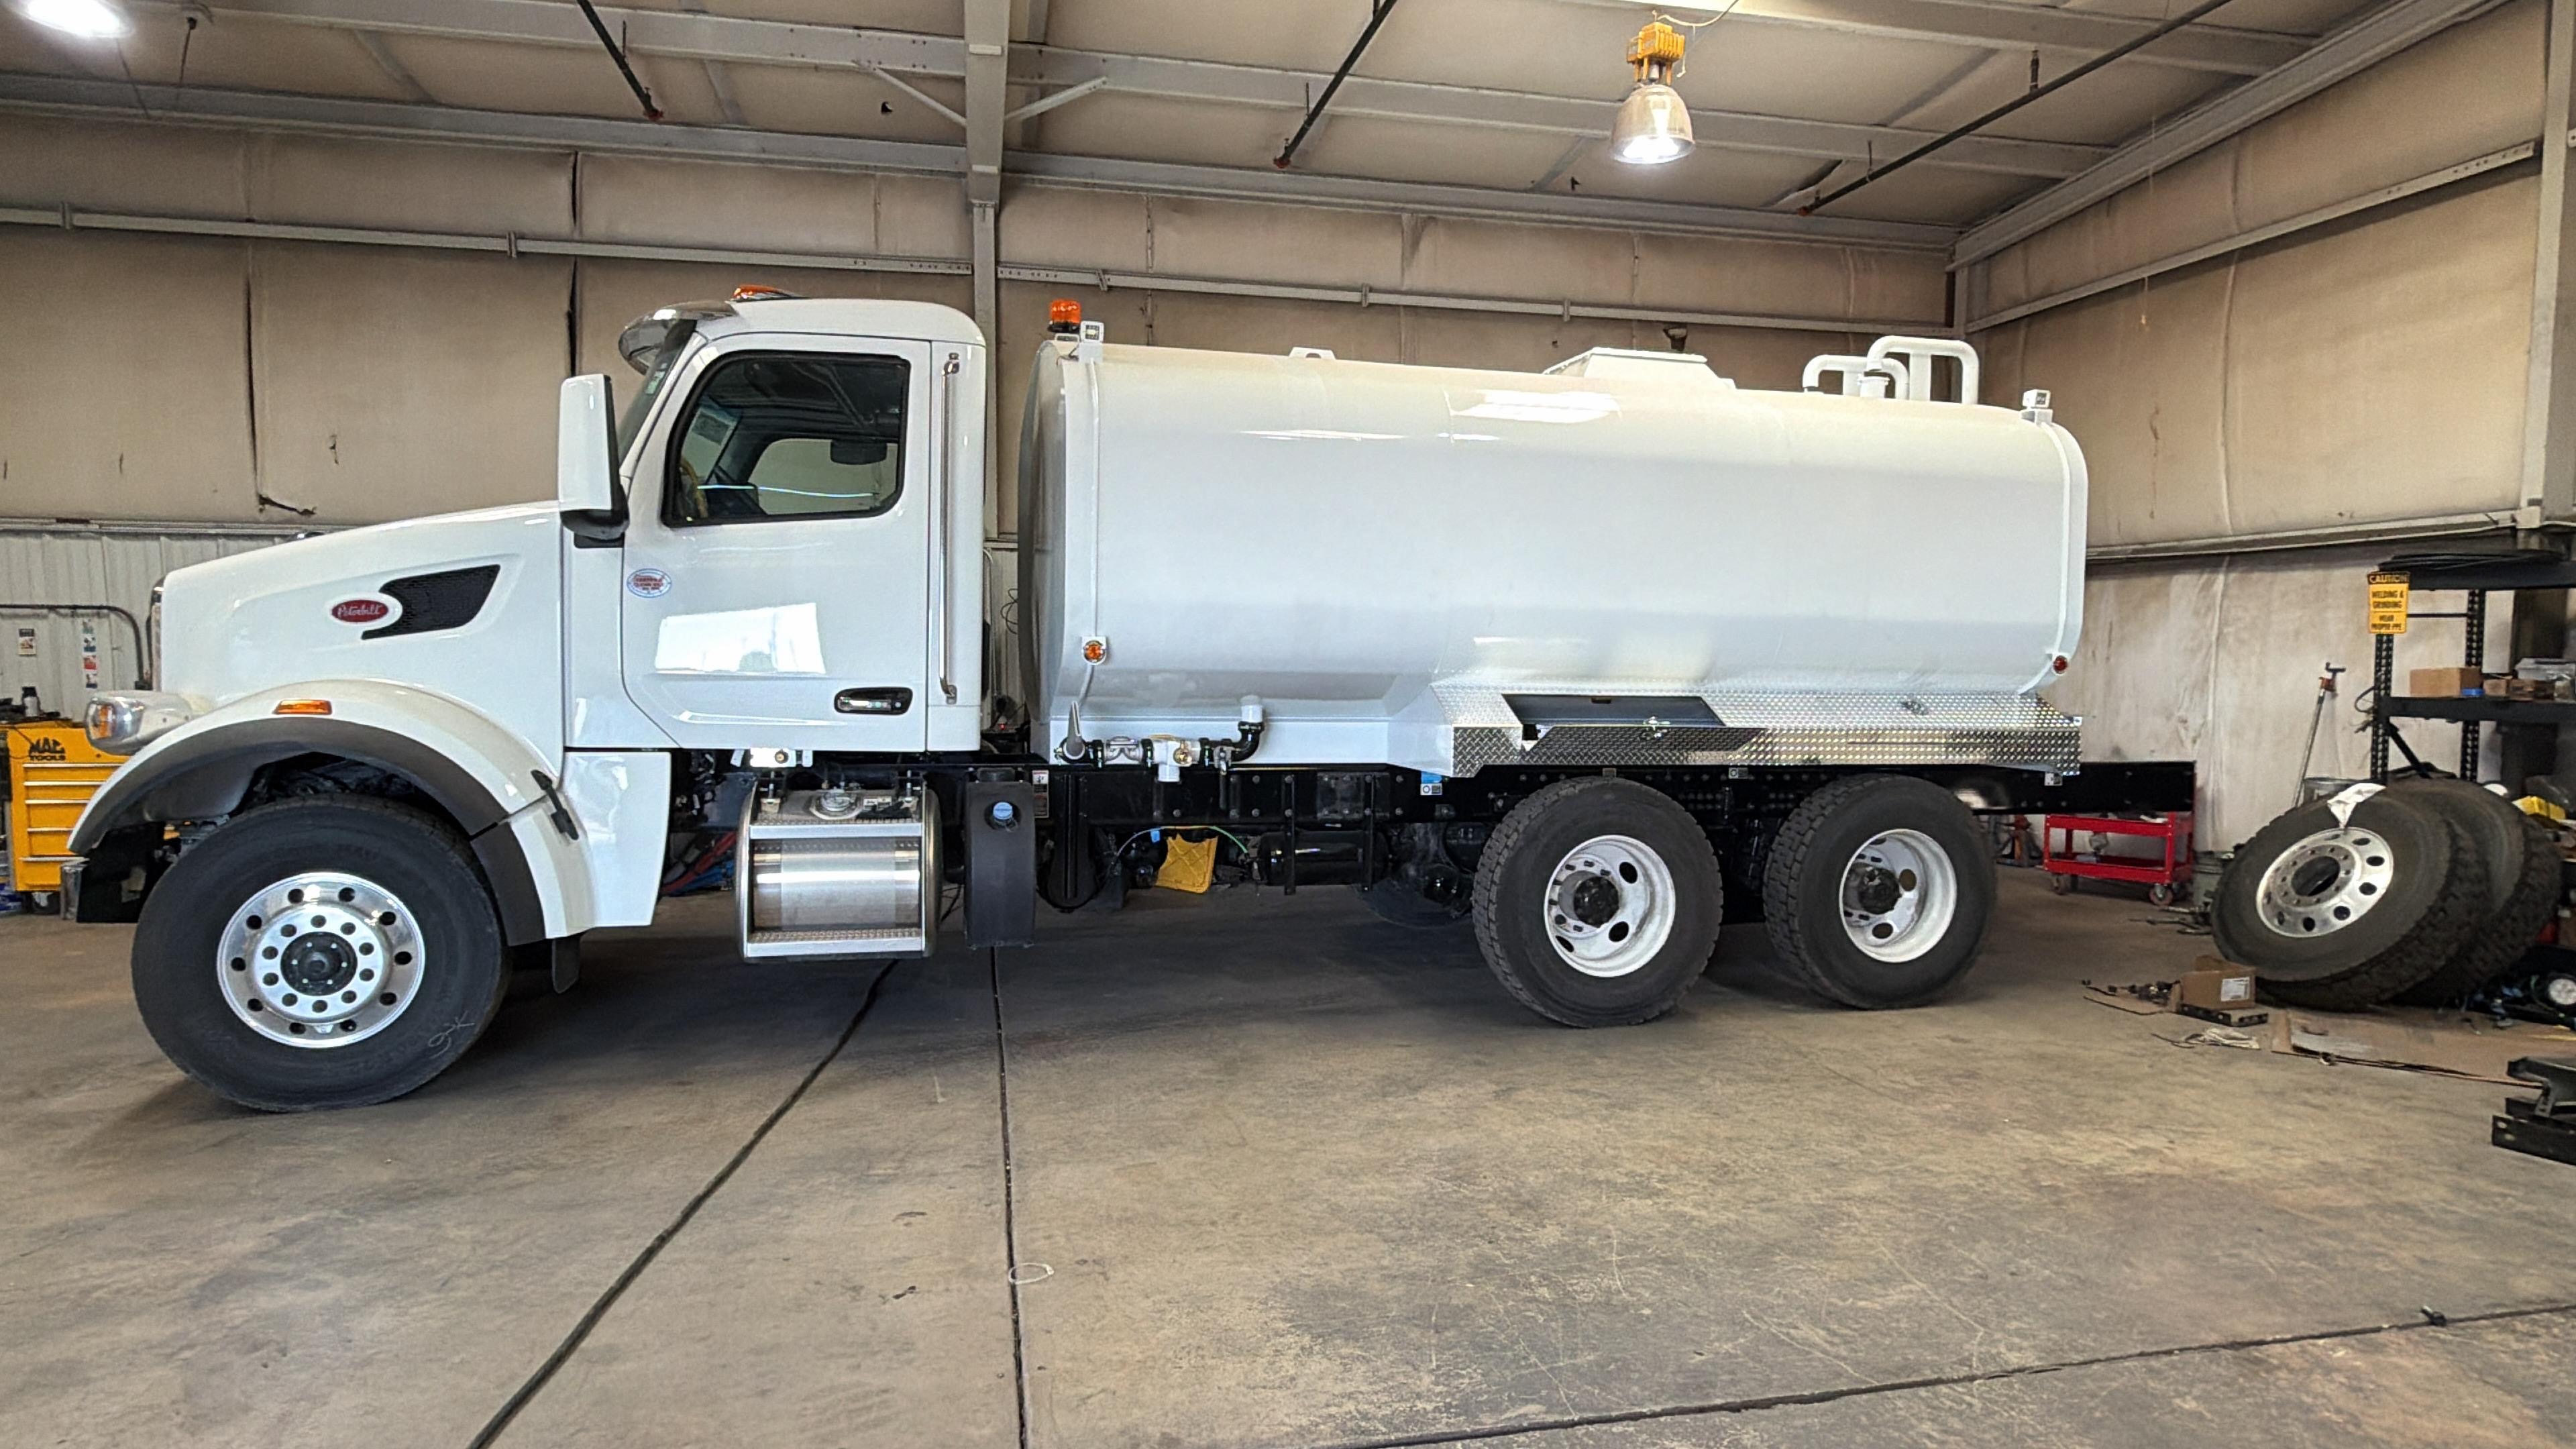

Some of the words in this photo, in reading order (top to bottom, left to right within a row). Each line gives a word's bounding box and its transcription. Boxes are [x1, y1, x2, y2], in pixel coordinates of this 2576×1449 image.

[2369, 574, 2408, 584] CAUTION
[2371, 590, 2398, 598] WELDING
[2373, 600, 2402, 608] GRINDING
[337, 604, 382, 617] Peterbilt
[29, 737, 65, 753] MAC
